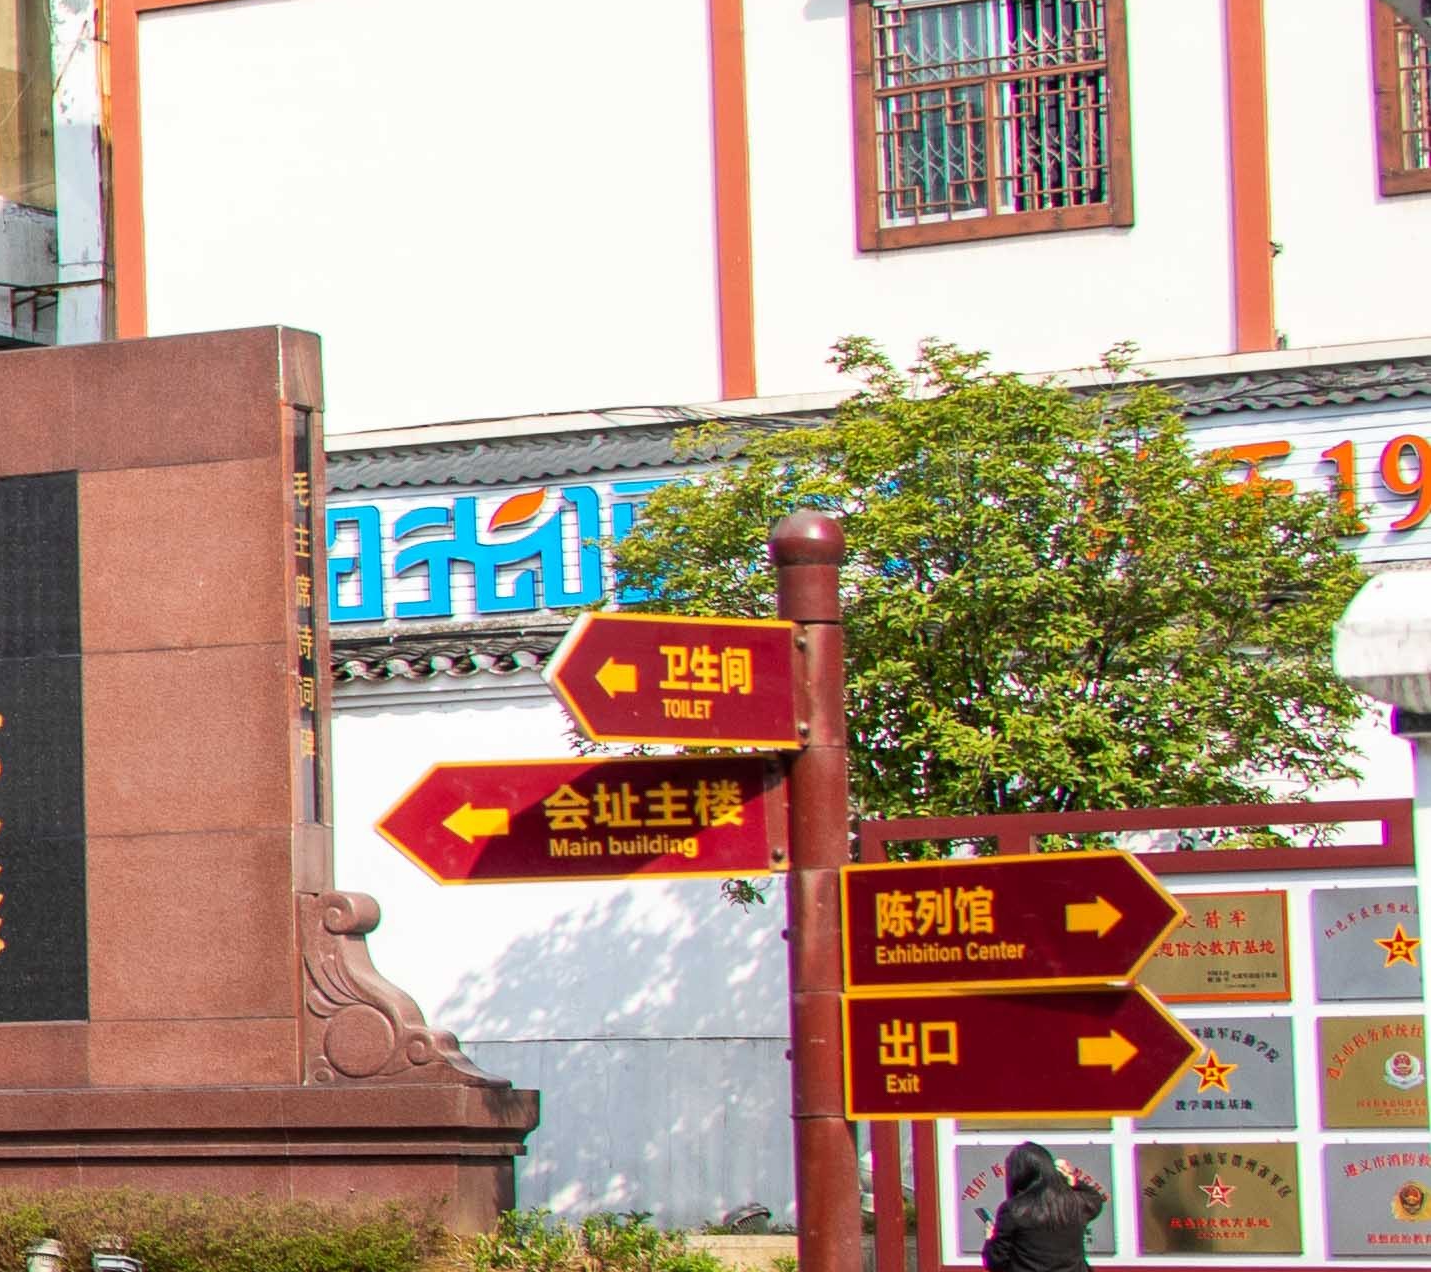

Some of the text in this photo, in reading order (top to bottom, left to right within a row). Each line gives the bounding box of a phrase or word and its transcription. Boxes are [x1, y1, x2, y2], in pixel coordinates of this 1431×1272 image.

[659, 645, 753, 695] 卫生间
[662, 699, 712, 719] TOILET
[543, 780, 743, 830] 会址主楼
[549, 835, 699, 859] Main building
[875, 886, 994, 938] 陈列馆
[876, 941, 1025, 965] Exhibition Center
[1152, 939, 1276, 958] 想信念教育基地
[879, 1020, 959, 1066] 出口
[886, 1074, 920, 1093] Exit
